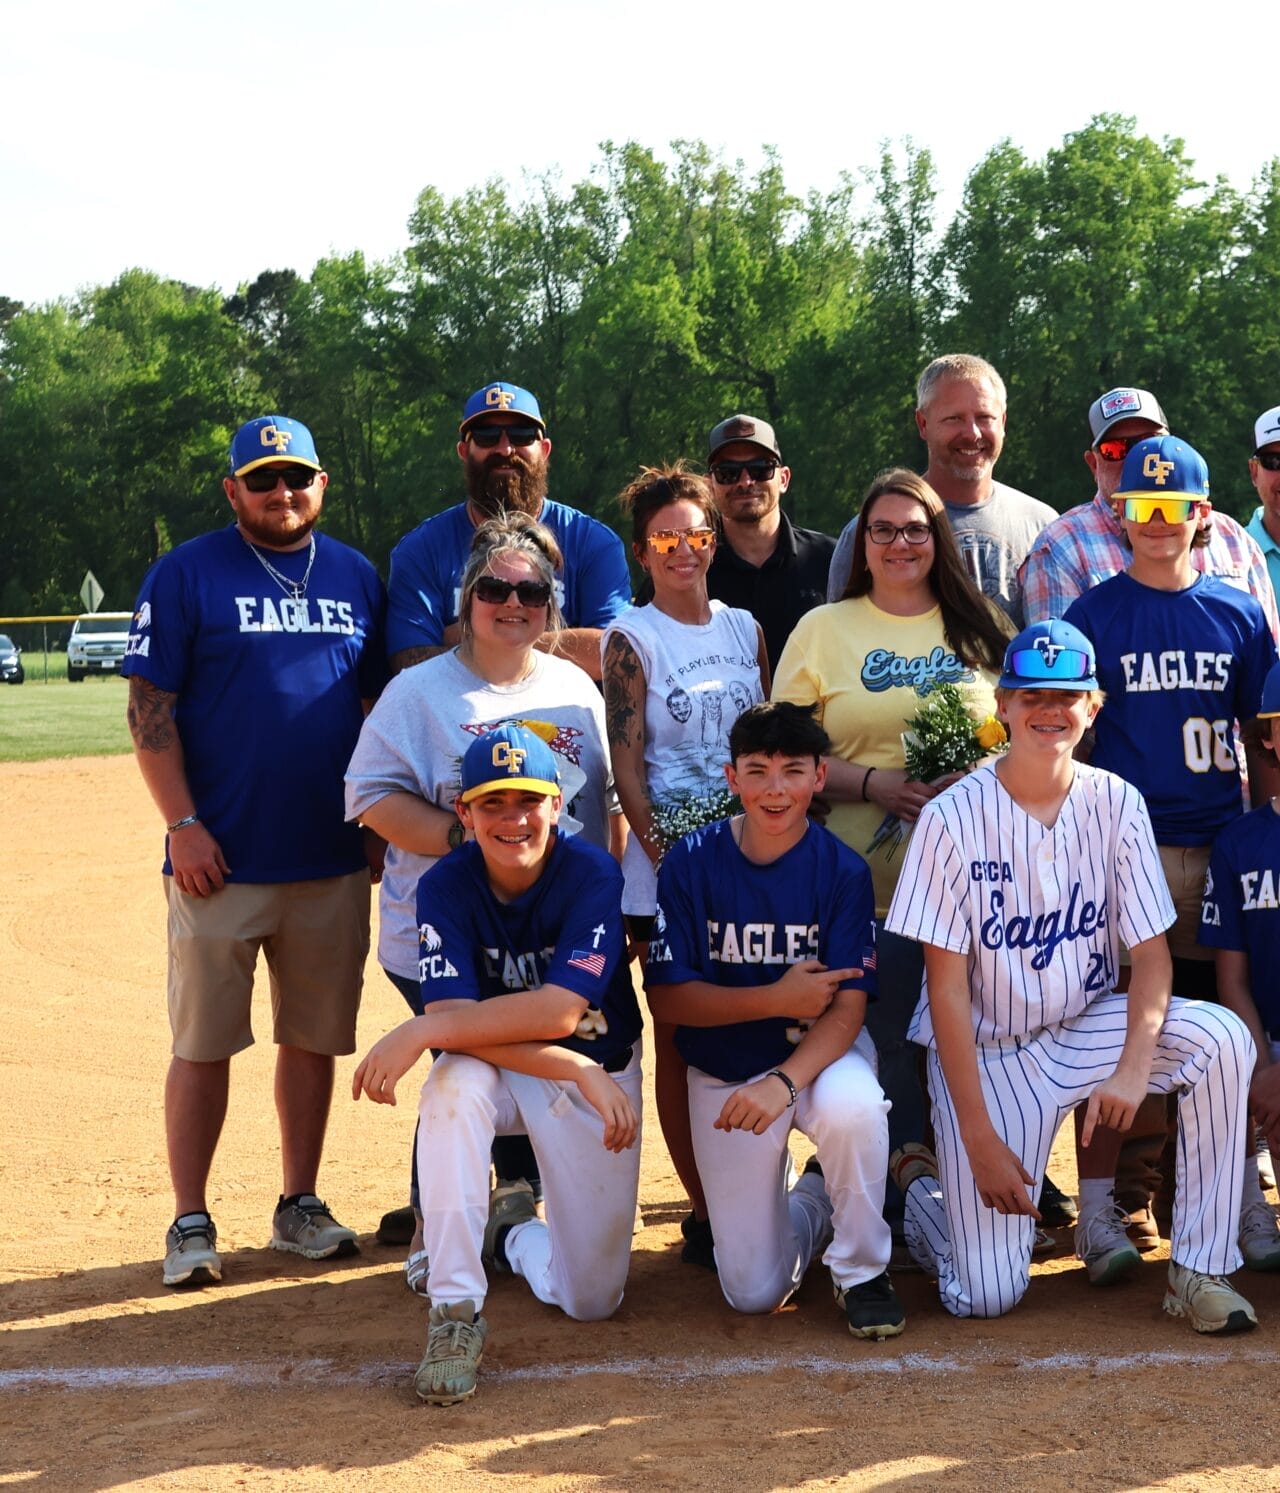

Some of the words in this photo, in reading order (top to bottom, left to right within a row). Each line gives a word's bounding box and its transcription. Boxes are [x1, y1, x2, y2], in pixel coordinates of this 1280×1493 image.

[485, 387, 516, 409] CF
[261, 425, 292, 452] CF
[1143, 453, 1175, 485] CF
[234, 597, 355, 636] EAGLES
[678, 655, 721, 676] PLAYLIST
[1120, 649, 1233, 692] EAGLES
[492, 742, 527, 773] CF
[706, 919, 820, 964] EAGLES
